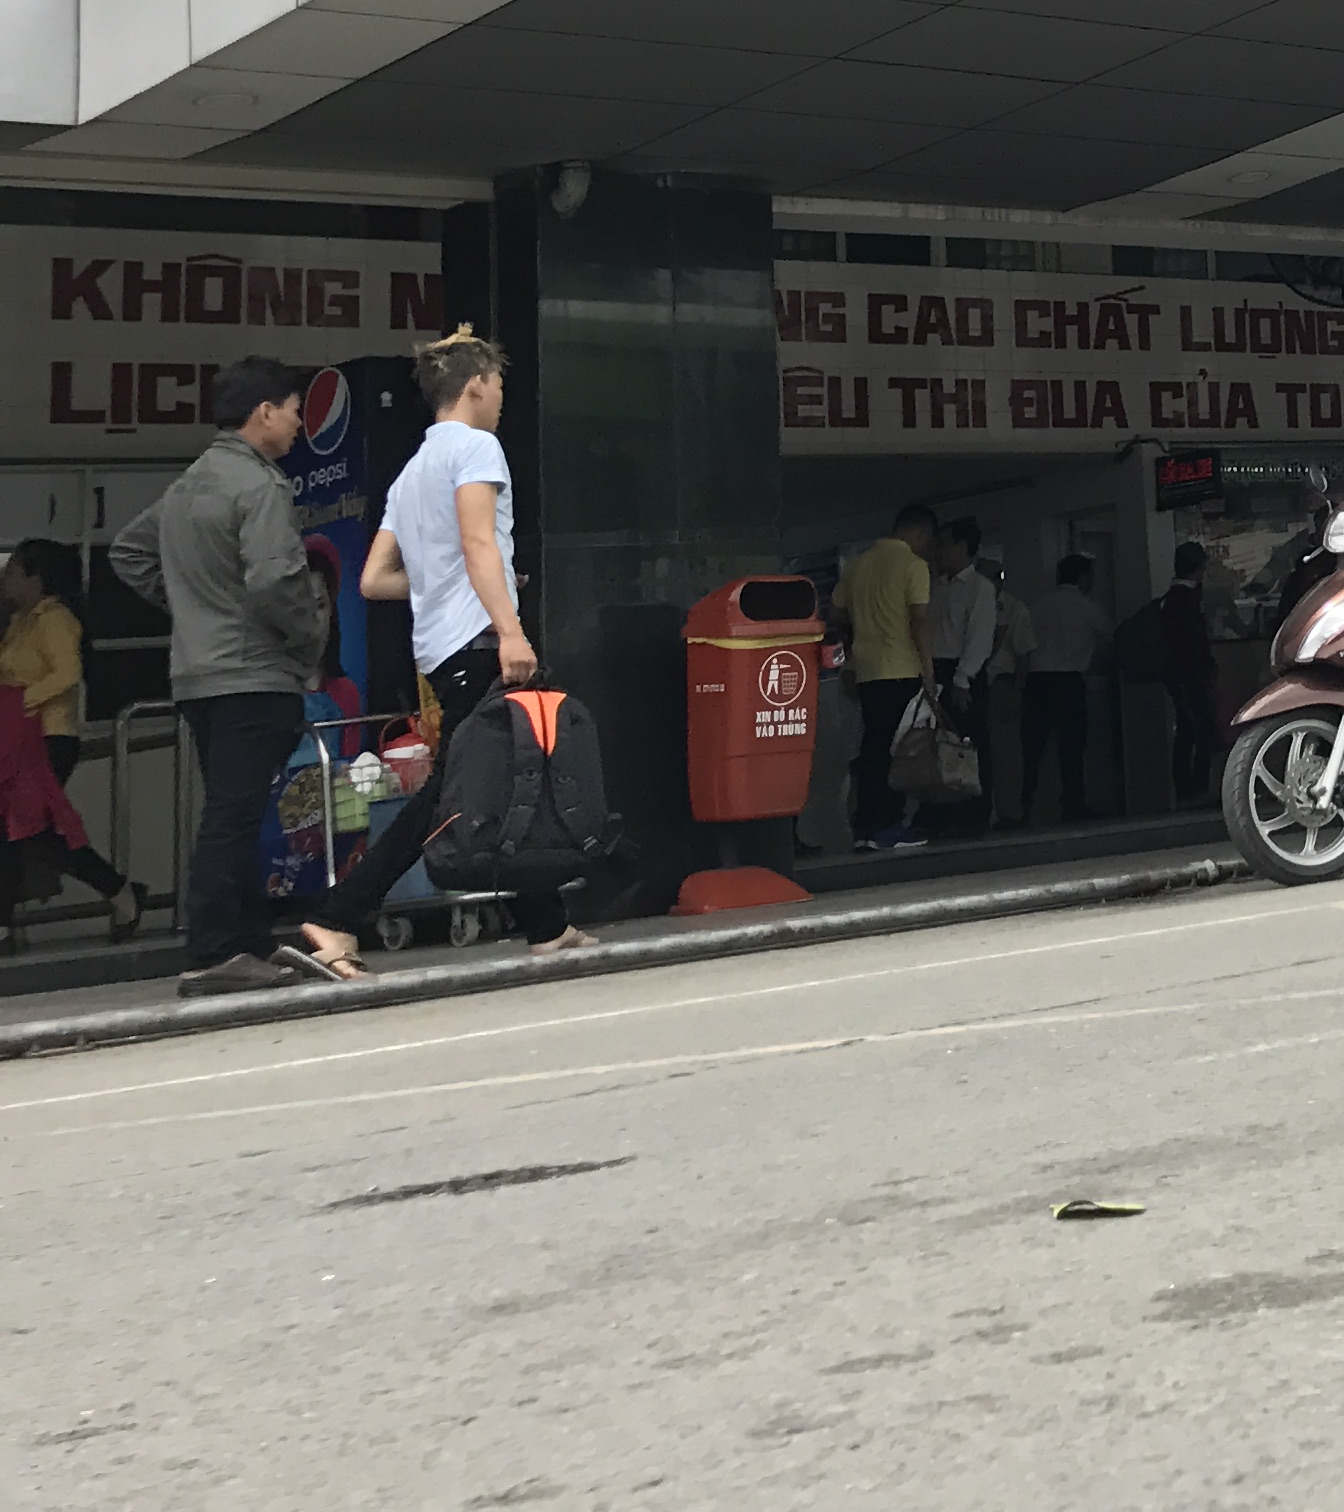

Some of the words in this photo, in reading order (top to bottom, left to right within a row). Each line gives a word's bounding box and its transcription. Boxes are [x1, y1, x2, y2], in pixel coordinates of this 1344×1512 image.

[51, 253, 361, 328] KHÔNG
[867, 292, 995, 348] CAO
[1014, 285, 1161, 351] CHẤT
[888, 377, 987, 428] THI
[1009, 379, 1129, 428] ĐUA
[1149, 368, 1259, 428] CỦA
[308, 457, 349, 493] pepsi
[755, 724, 775, 738] VÀO
[756, 711, 772, 724] XIN
[788, 706, 808, 721] RÁC
